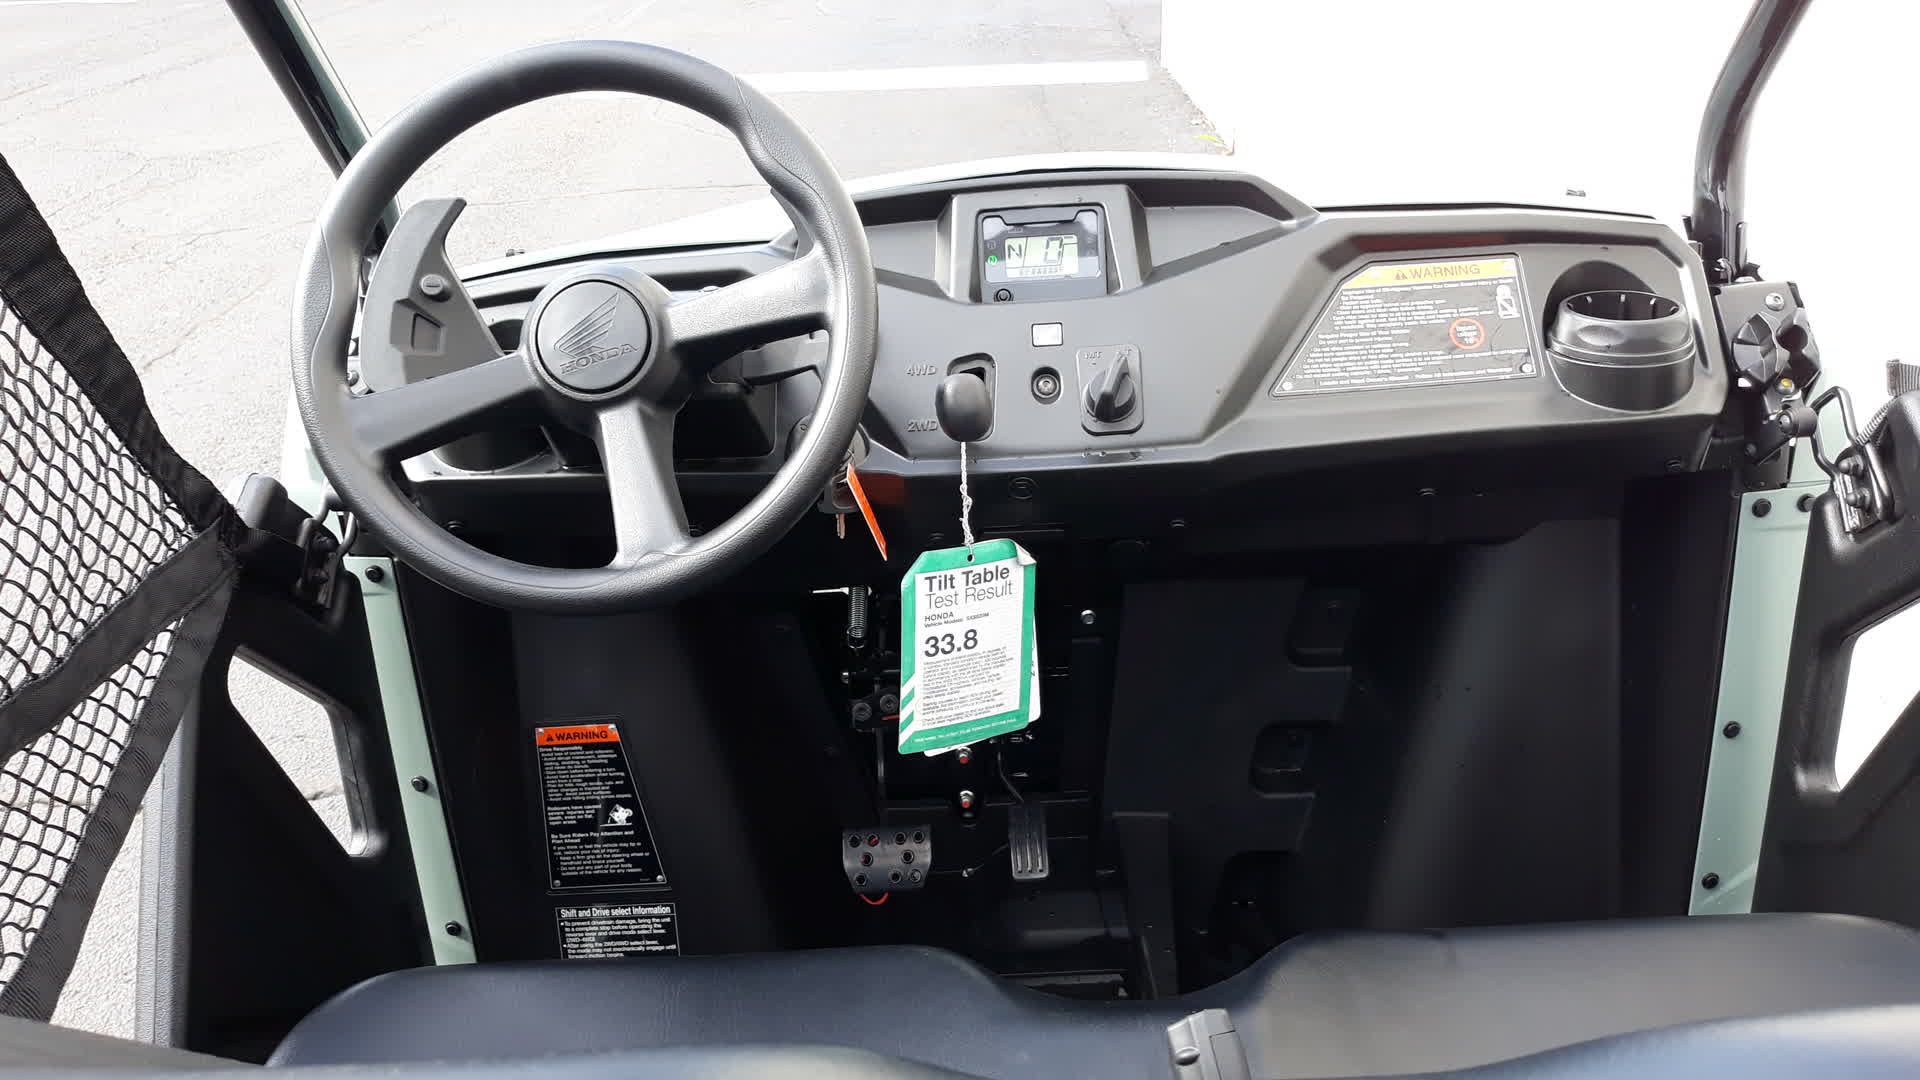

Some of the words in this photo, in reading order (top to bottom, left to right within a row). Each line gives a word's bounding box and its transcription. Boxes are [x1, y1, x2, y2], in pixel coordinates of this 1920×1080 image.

[1008, 244, 1022, 259] N
[1409, 264, 1480, 279] WARNING
[559, 343, 638, 375] HONDA
[905, 363, 937, 376] 4WD
[906, 420, 938, 432] 2WD
[925, 574, 955, 592] Tilt
[961, 565, 1009, 586] Table
[925, 591, 959, 609] Test
[965, 580, 1012, 603] Result
[925, 612, 953, 622] HONDA
[925, 629, 978, 657] 33.8
[556, 731, 608, 740] WARNING
[561, 909, 577, 918] Shift
[578, 909, 591, 917] and
[592, 908, 610, 916] Drive
[611, 907, 631, 915] select
[632, 905, 671, 914] Information
